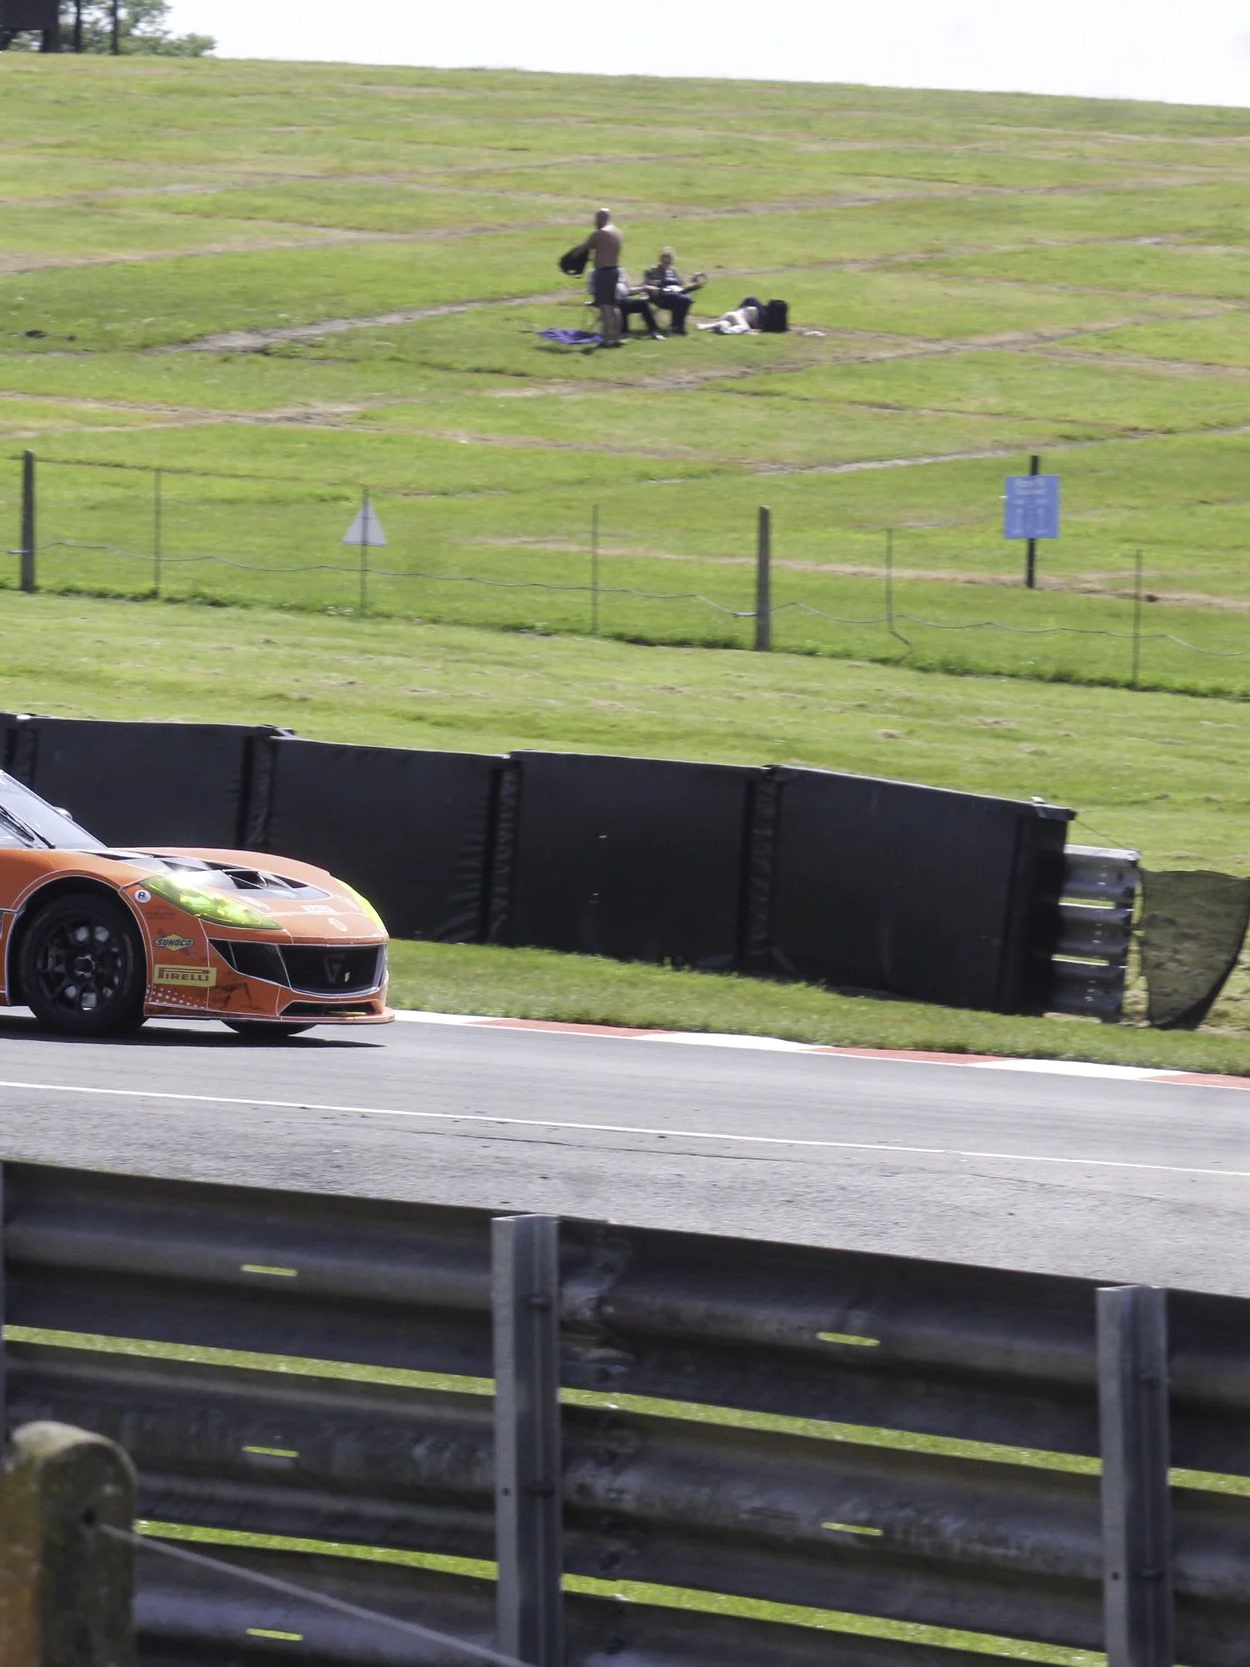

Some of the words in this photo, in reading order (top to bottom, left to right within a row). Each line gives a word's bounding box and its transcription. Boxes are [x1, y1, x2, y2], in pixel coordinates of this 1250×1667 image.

[137, 891, 146, 899] R
[156, 938, 192, 947] SUNOCO
[158, 967, 210, 982] PIRELLI
